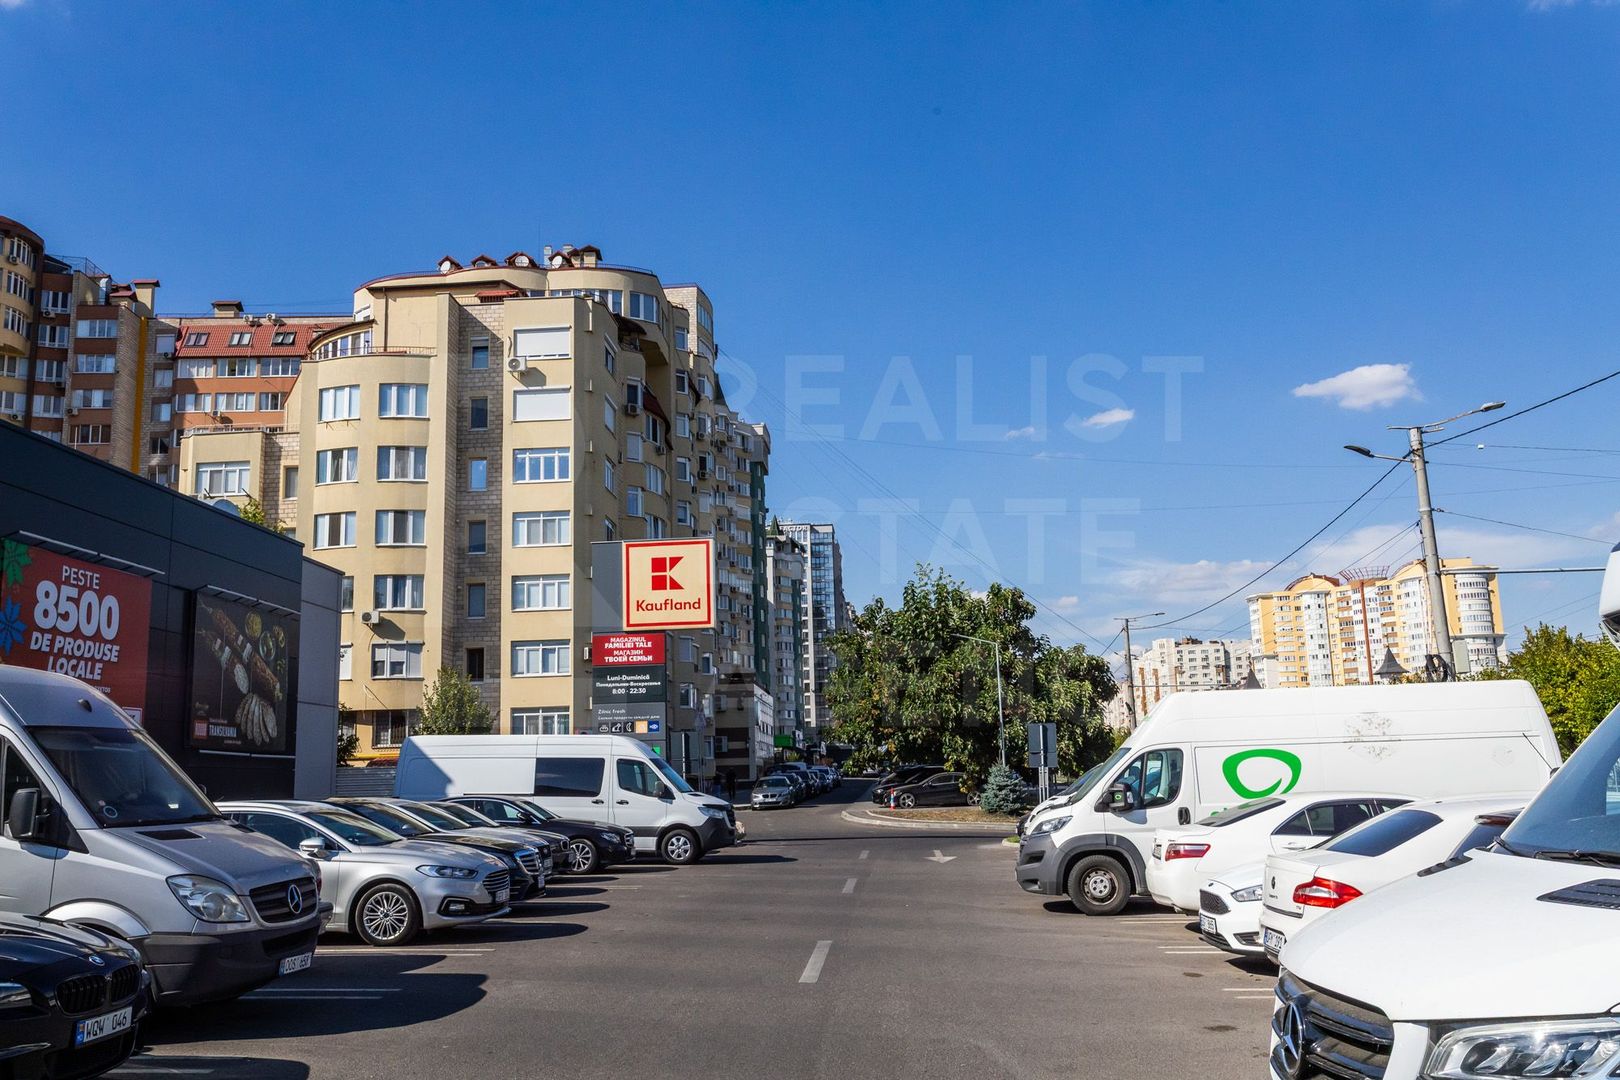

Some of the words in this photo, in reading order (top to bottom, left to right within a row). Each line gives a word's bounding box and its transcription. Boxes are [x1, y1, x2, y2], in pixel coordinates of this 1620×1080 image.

[62, 565, 100, 590] PESTE
[33, 580, 120, 641] 8500
[636, 598, 701, 612] Kaufland
[30, 631, 52, 652] DE
[53, 635, 120, 662] PRODUSE
[604, 655, 628, 663] ТВОЕЙ
[47, 655, 104, 681] LOCALE
[86, 1018, 105, 1040] WQW
[112, 1010, 127, 1030] 046
